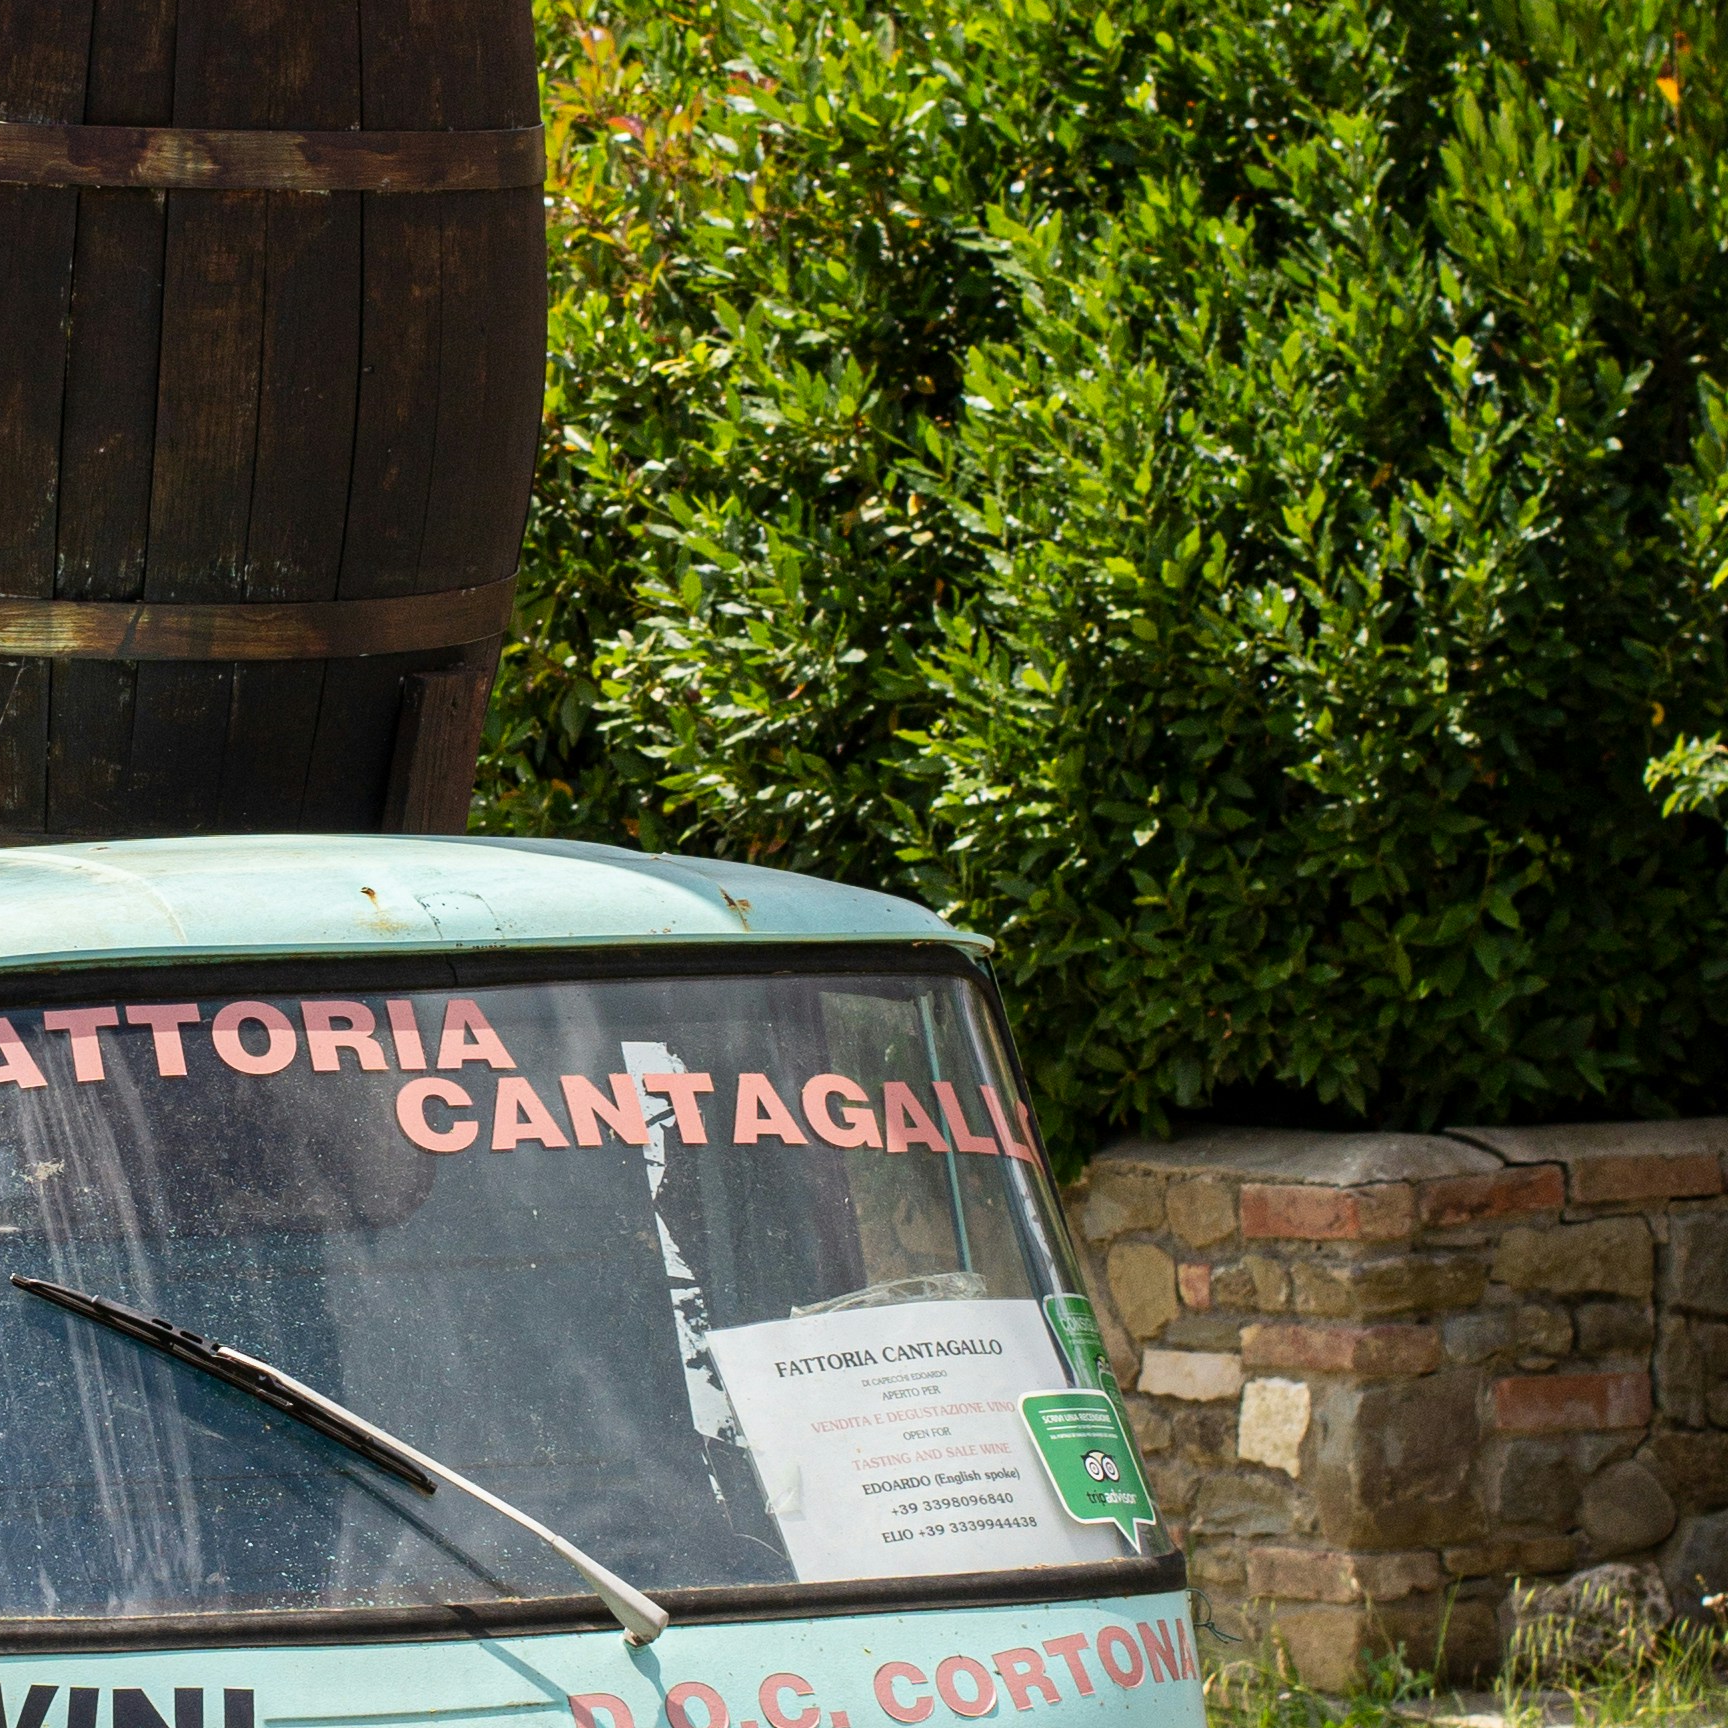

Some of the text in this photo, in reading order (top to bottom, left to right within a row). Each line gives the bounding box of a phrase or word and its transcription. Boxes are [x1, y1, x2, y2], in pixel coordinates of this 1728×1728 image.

[774, 1339, 1003, 1378] FATTORIA CANTAGALLO
[882, 1385, 941, 1401] APERTO PER
[811, 1400, 1015, 1434] VENDITA E DEGUSTAZIONE VINO
[903, 1427, 952, 1441] OPEN FOR
[852, 1442, 1012, 1472] TASTING AND SALE WINE
[862, 1467, 1021, 1496] EDOARDO (English spoke)
[891, 1492, 1014, 1517] +39 3398096840
[1087, 1488, 1137, 1506] tripadvisor
[882, 1516, 1038, 1543] ELIO +39 3339944438
[873, 1618, 1197, 1724] CORTONA
